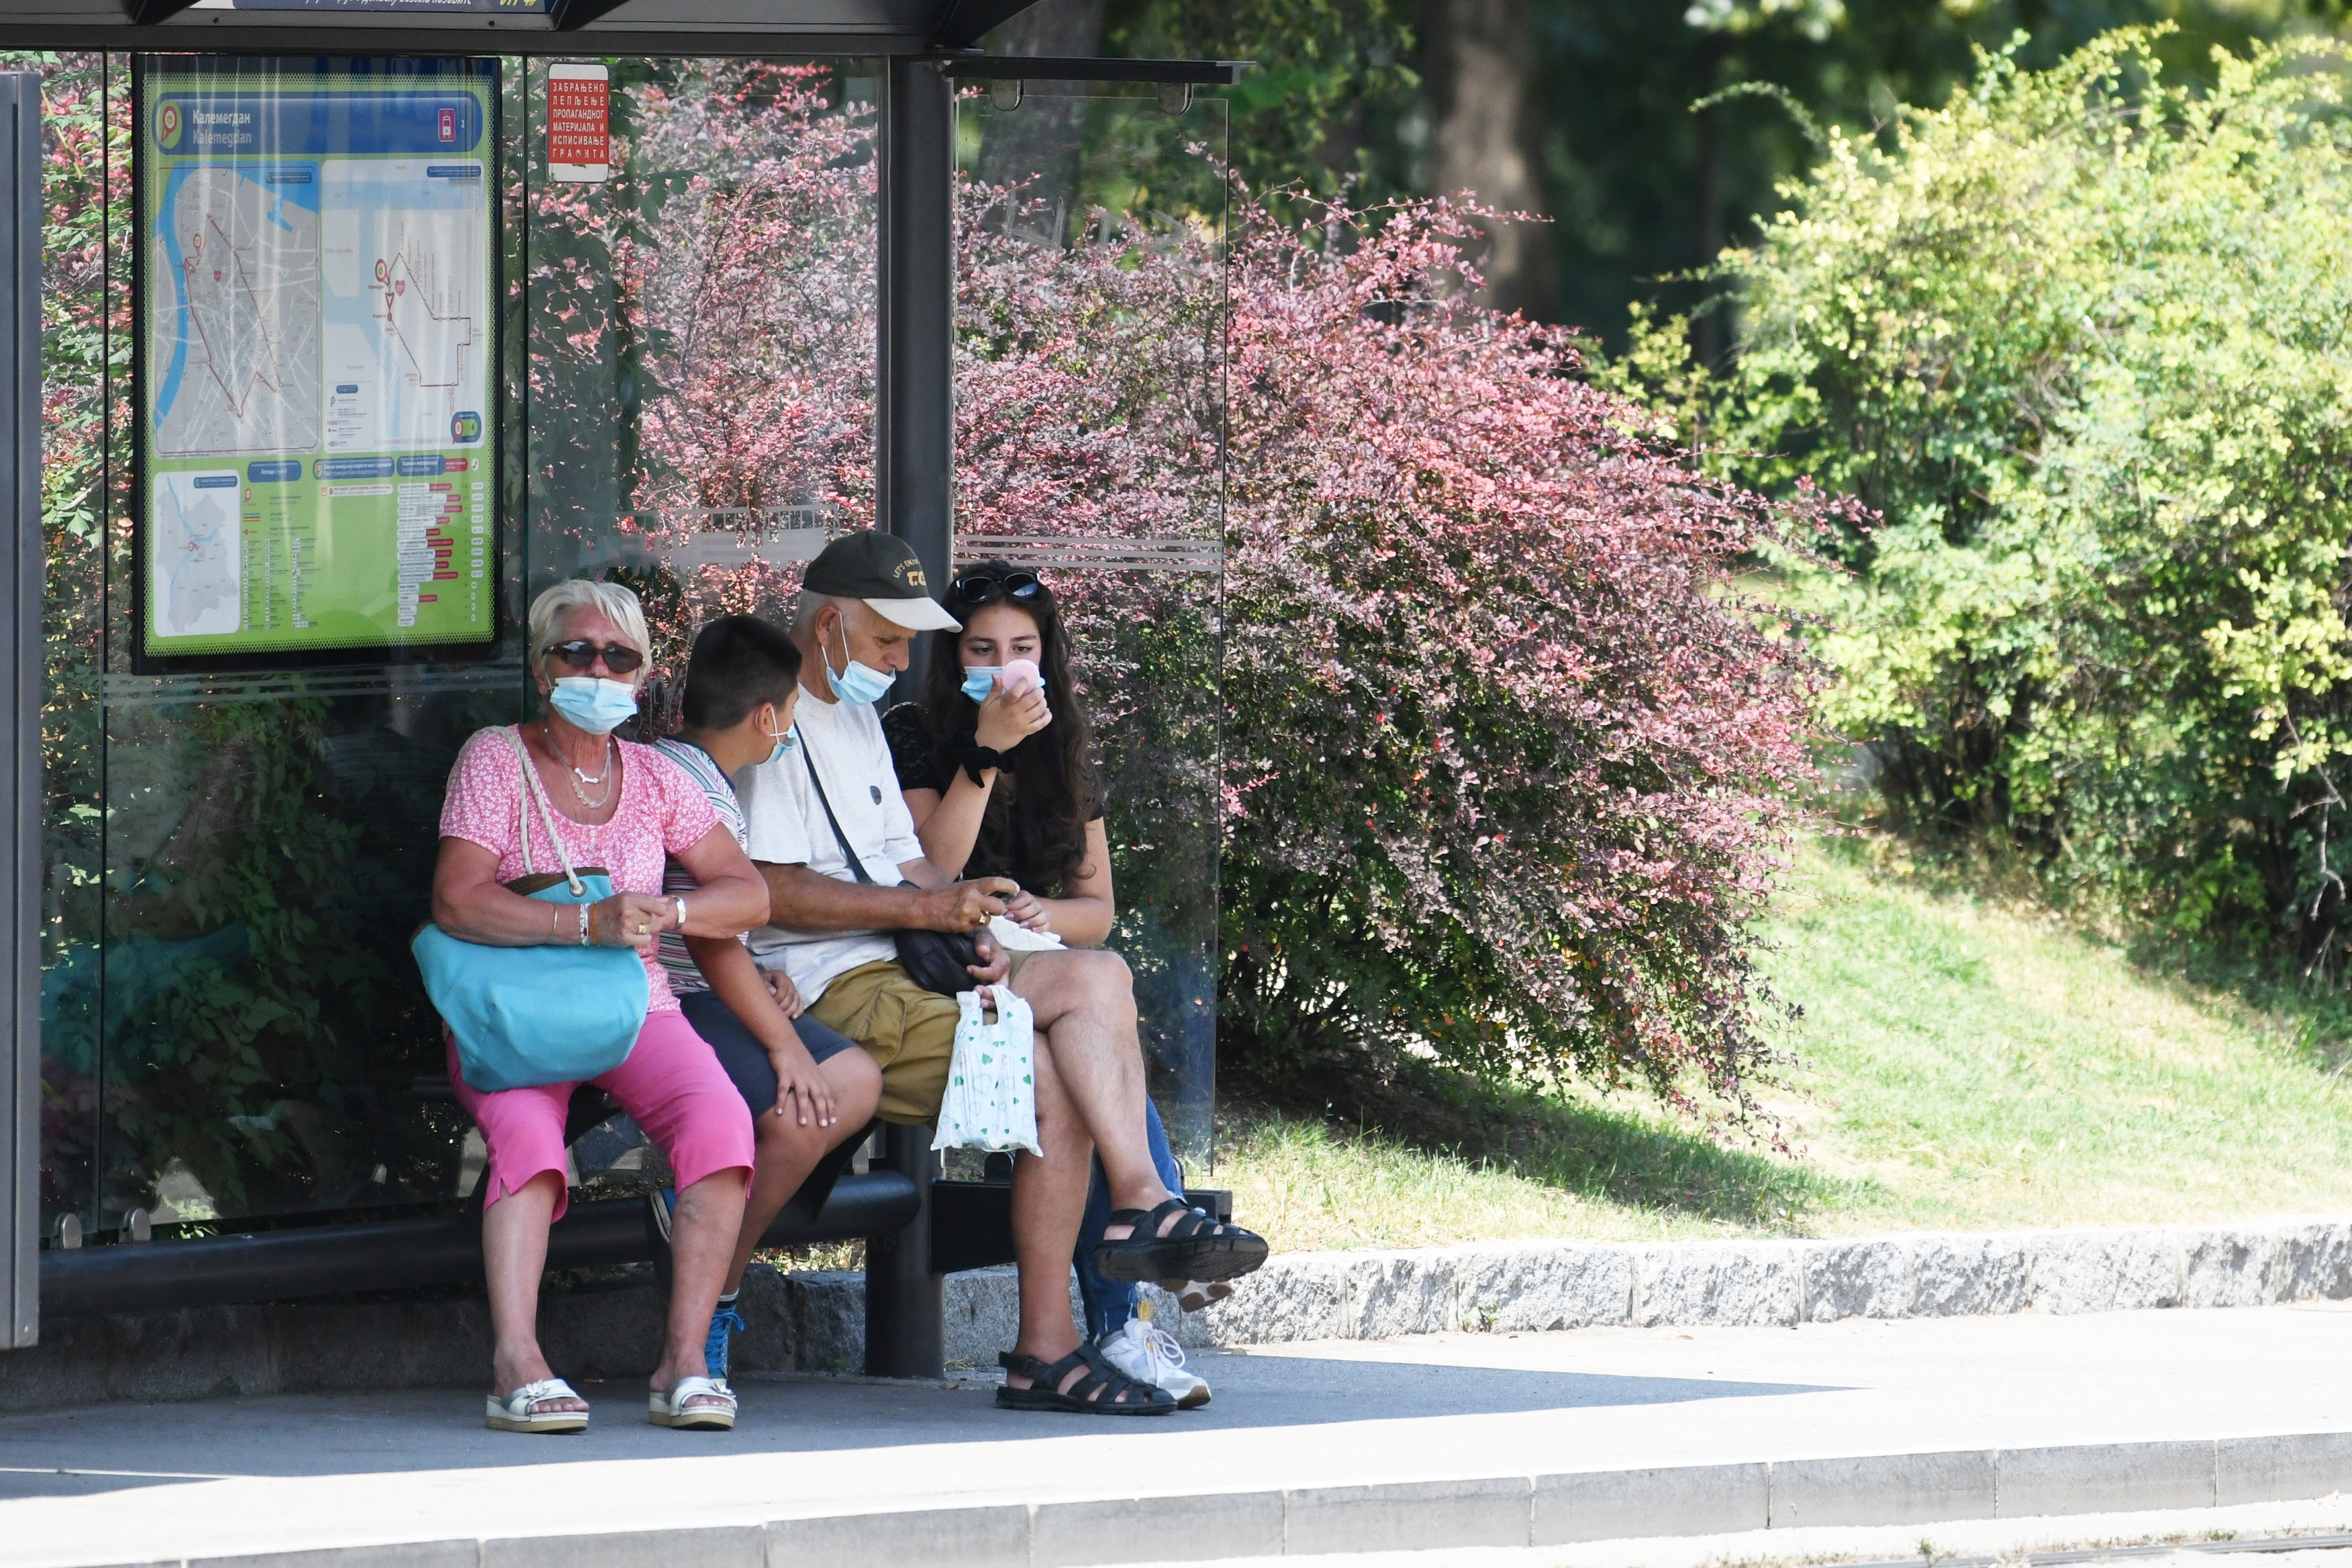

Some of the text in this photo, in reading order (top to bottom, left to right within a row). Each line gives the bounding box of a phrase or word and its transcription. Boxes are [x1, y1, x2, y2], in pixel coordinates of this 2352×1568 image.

[553, 83, 604, 92] ЗАБРАЊЕНО
[553, 96, 604, 106] ЛЕПЉЕЊЕ
[193, 110, 250, 127] Калемегдан
[553, 109, 604, 120] ПРОПАГАНДНОГ
[553, 122, 604, 132] МАТЕРИЈАЛА И
[193, 129, 251, 148] Kalemegdan
[553, 136, 604, 145] ИСПИСИВАЊЕ
[553, 149, 604, 158] ГРАФИТА
